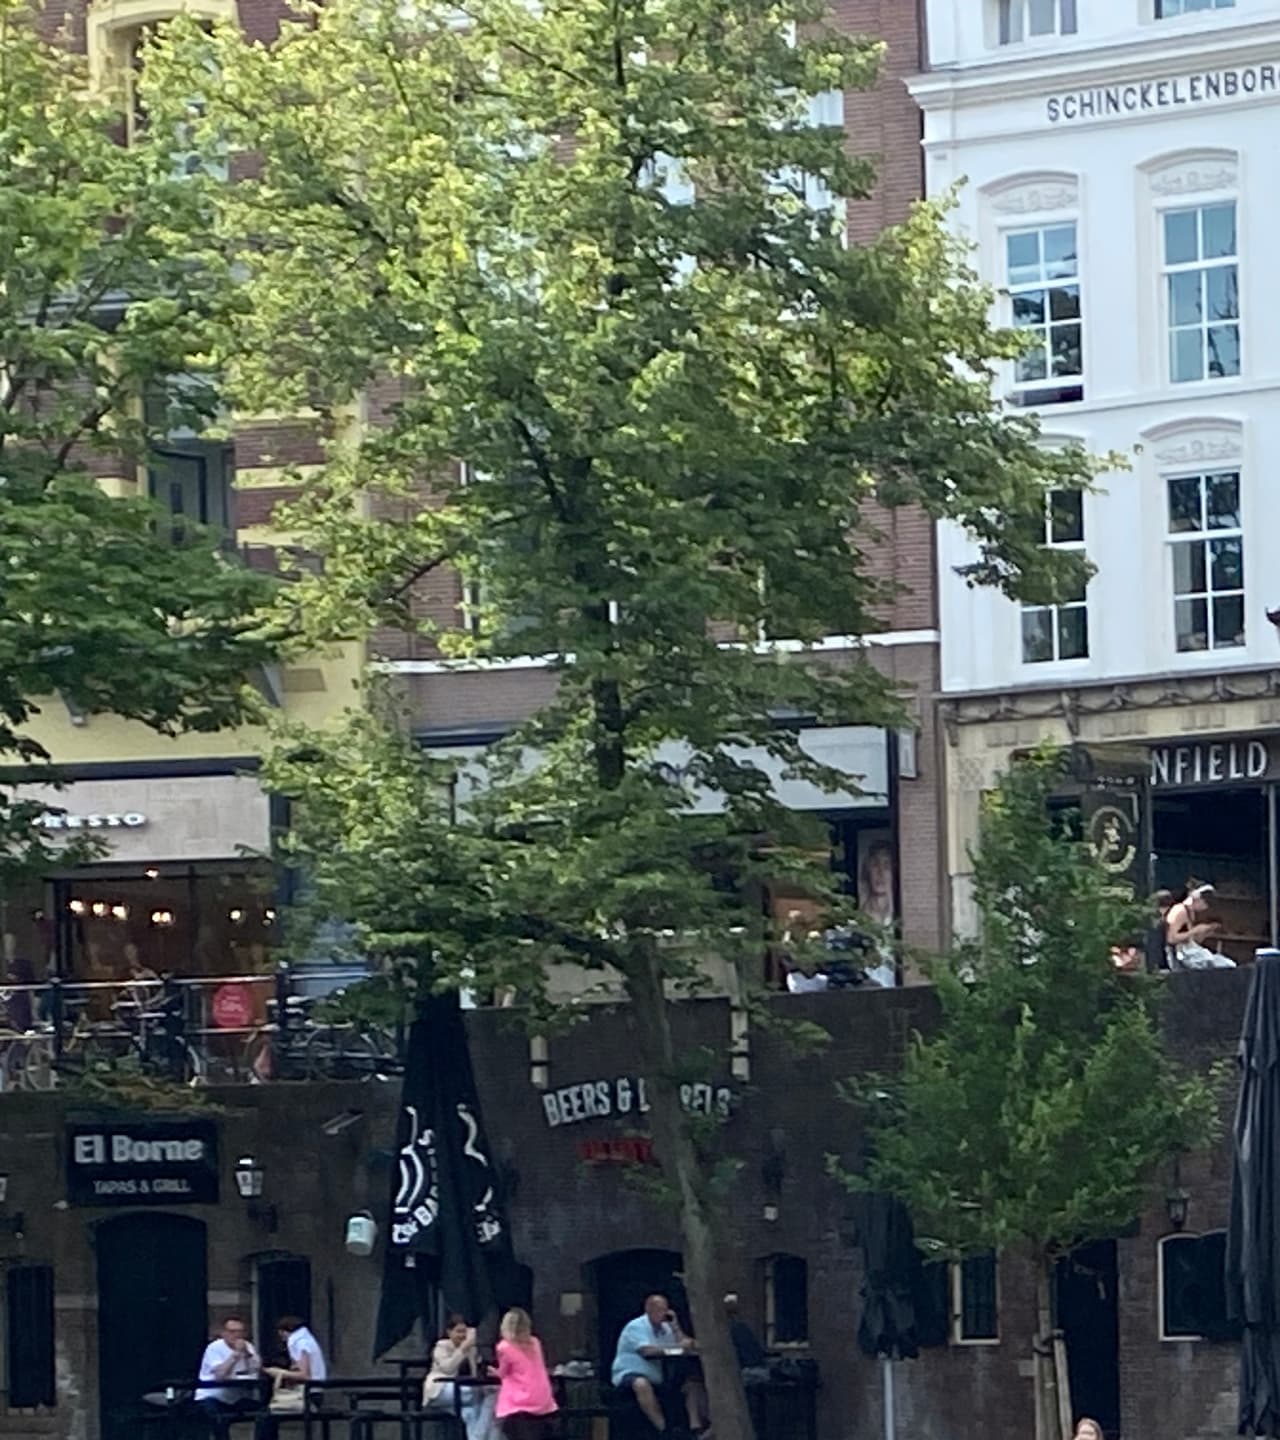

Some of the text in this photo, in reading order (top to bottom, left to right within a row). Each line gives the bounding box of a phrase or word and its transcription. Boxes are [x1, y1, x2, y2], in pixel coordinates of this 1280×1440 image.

[542, 1080, 611, 1127] BEERS
[74, 1134, 204, 1163] El Borne
